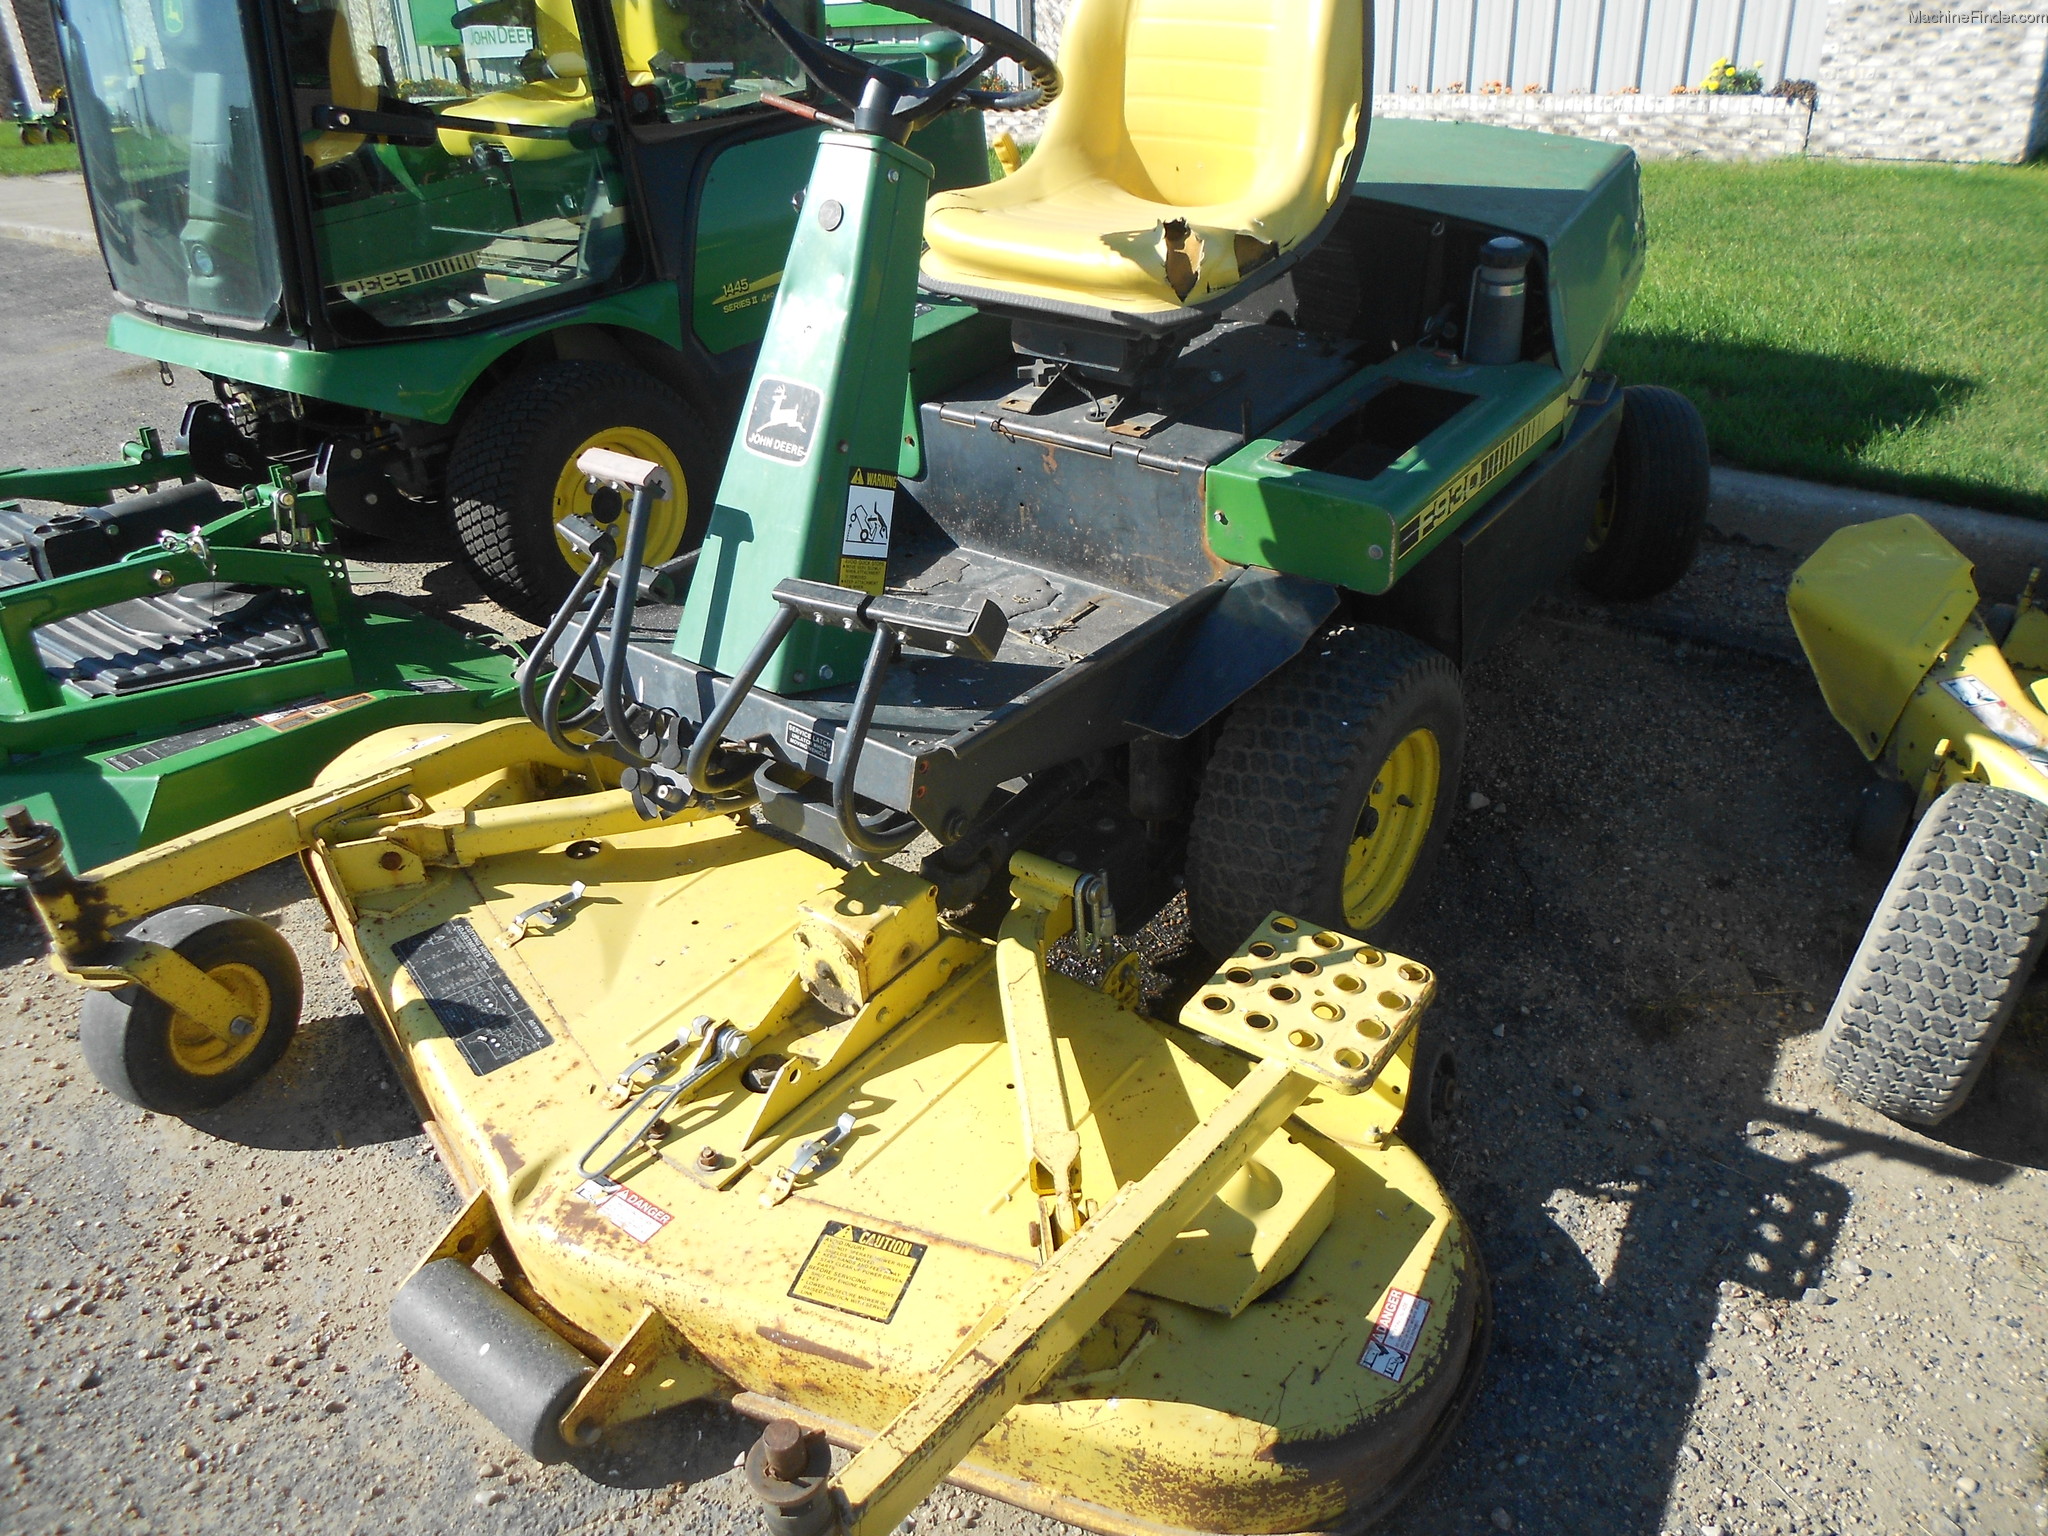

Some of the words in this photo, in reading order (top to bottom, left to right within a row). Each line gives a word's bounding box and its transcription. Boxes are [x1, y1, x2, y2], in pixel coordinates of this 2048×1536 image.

[471, 28, 497, 45] JOHN
[722, 278, 750, 297] 1445
[722, 298, 751, 314] SERIES
[748, 432, 773, 448] JOHN
[773, 438, 804, 457] DEERE
[866, 471, 897, 489] WARNING
[1418, 463, 1482, 541] F930
[813, 735, 830, 748] LATCH
[455, 924, 482, 957] ADJUSTMENTS
[464, 925, 482, 945] CUTTING
[478, 945, 495, 963] HEIGHT
[628, 1193, 671, 1224] DANGER
[859, 1231, 913, 1256] CAUTION
[1376, 1289, 1402, 1332] DANGER
